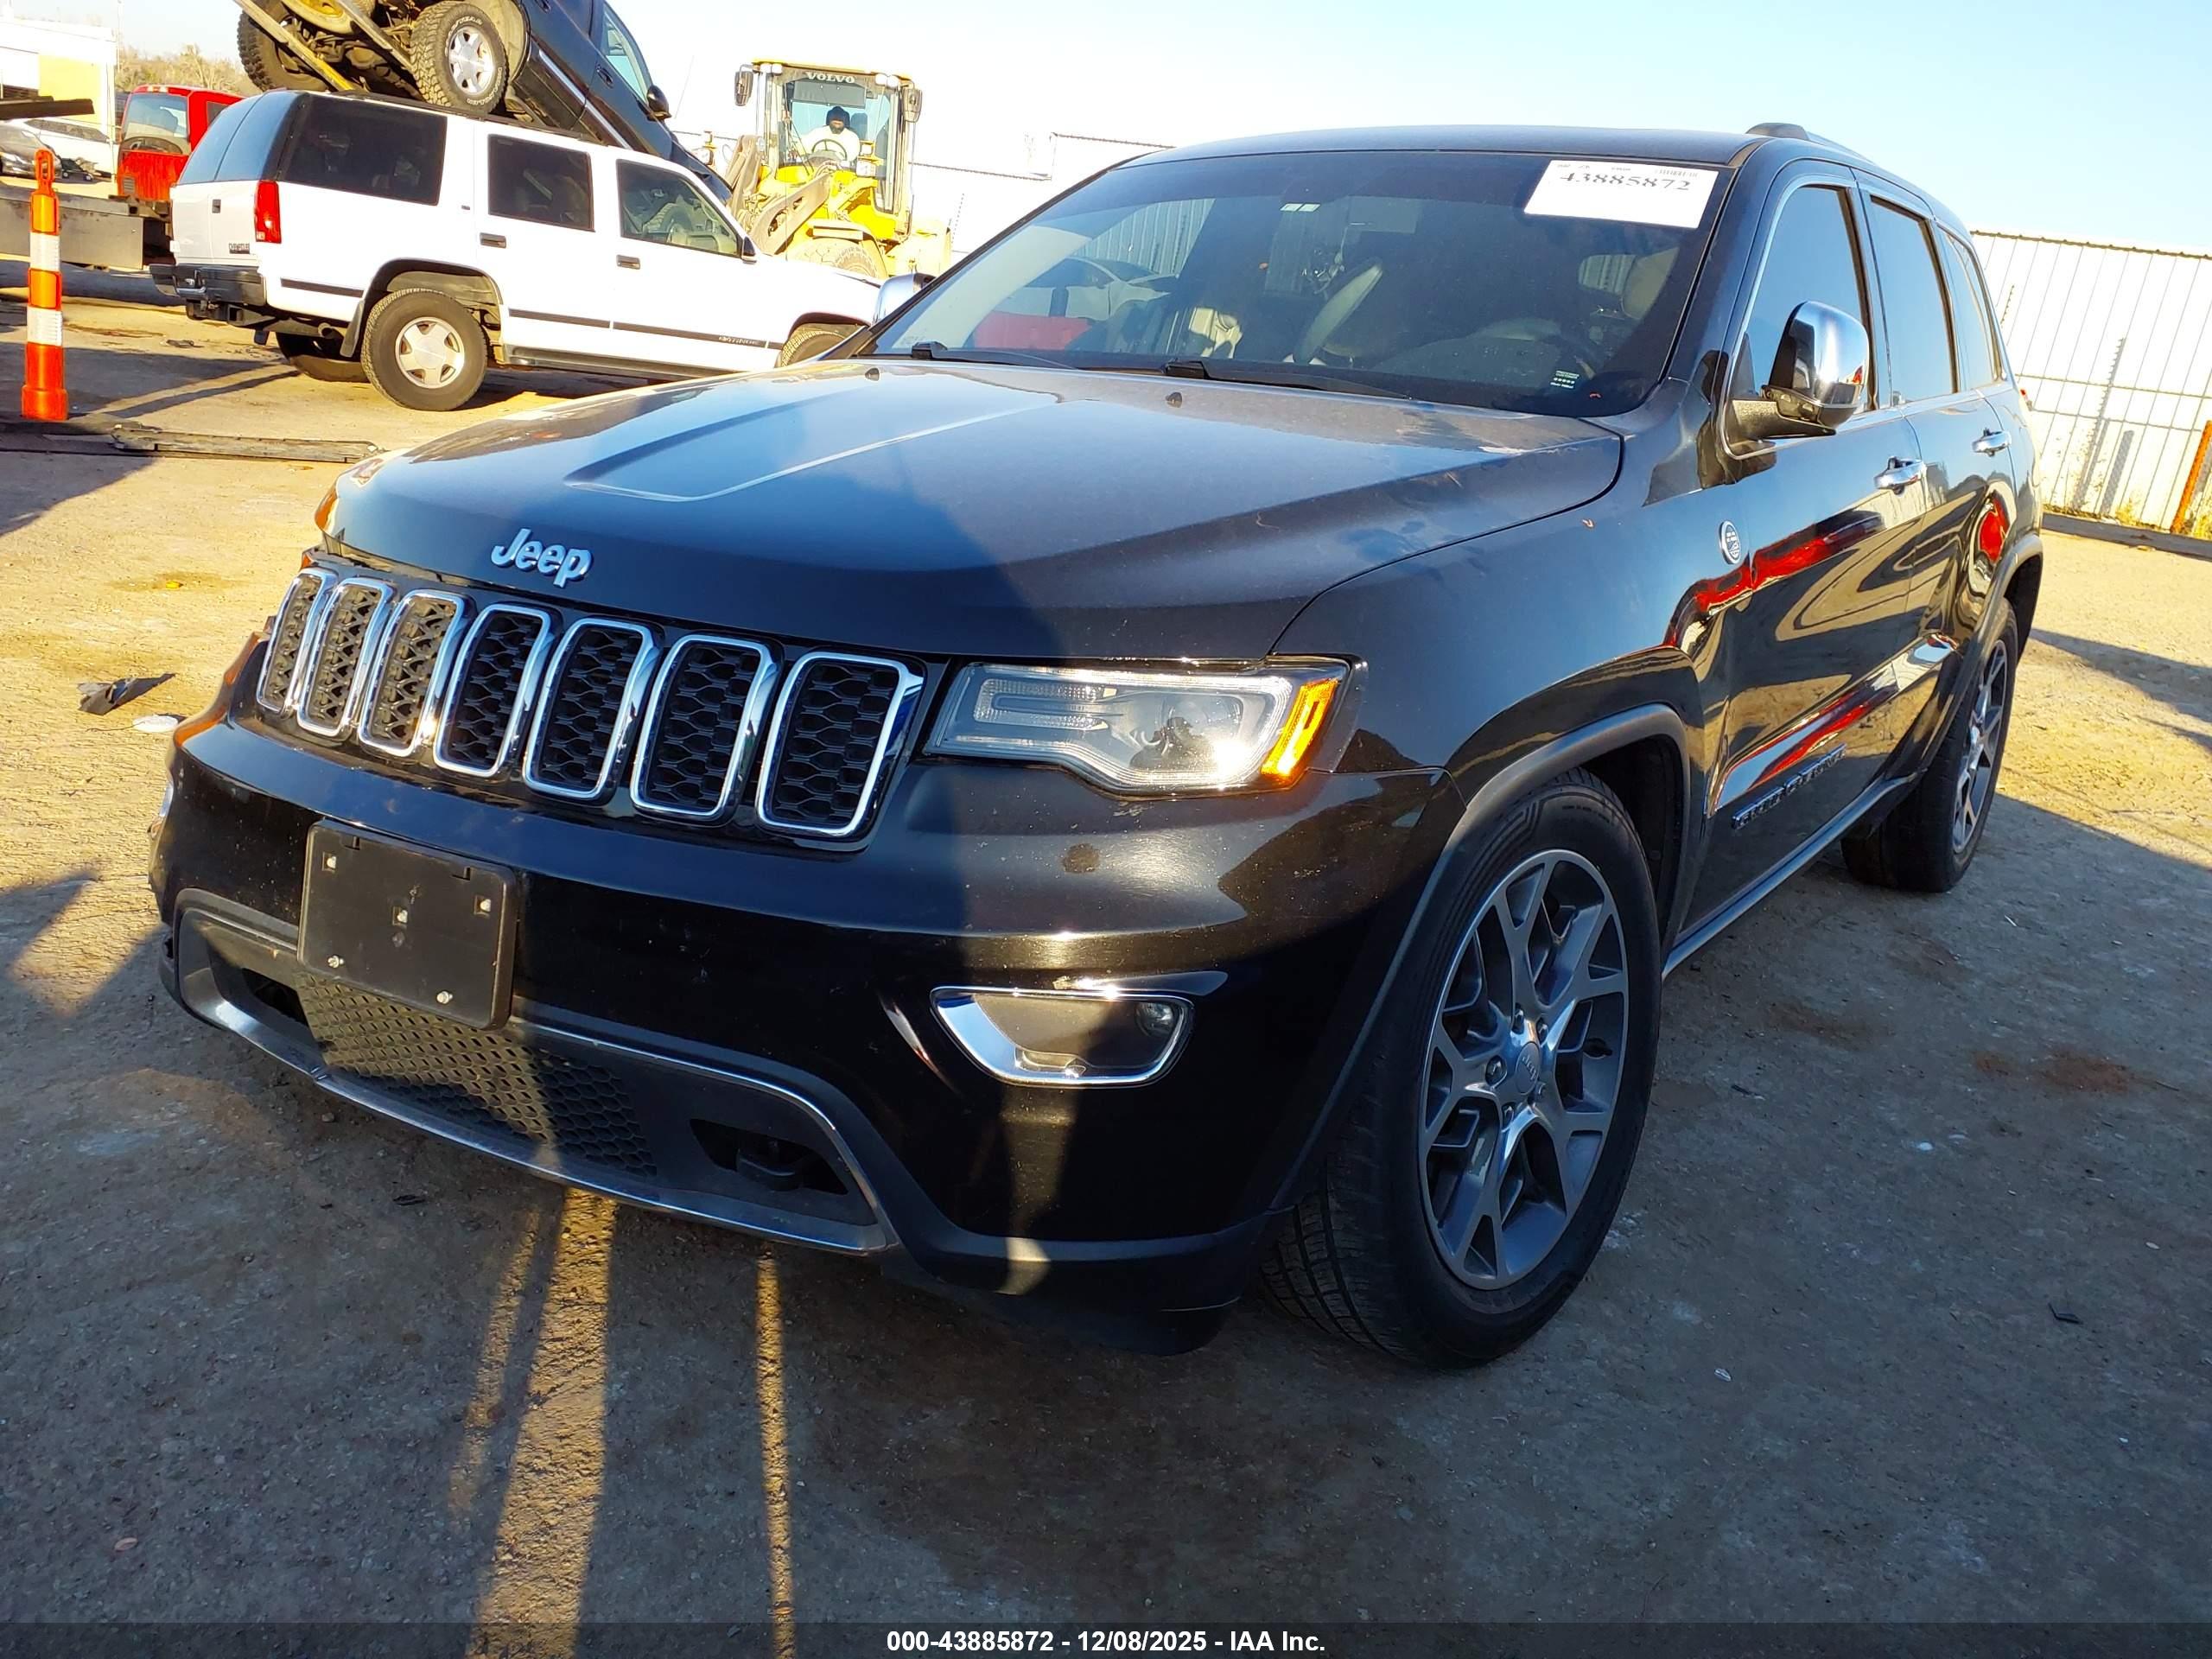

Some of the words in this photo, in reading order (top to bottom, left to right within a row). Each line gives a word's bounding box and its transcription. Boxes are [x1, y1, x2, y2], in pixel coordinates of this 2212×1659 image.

[805, 71, 855, 84] VOLVO
[1560, 172, 1691, 191] 43885872
[491, 527, 594, 588] Jeep
